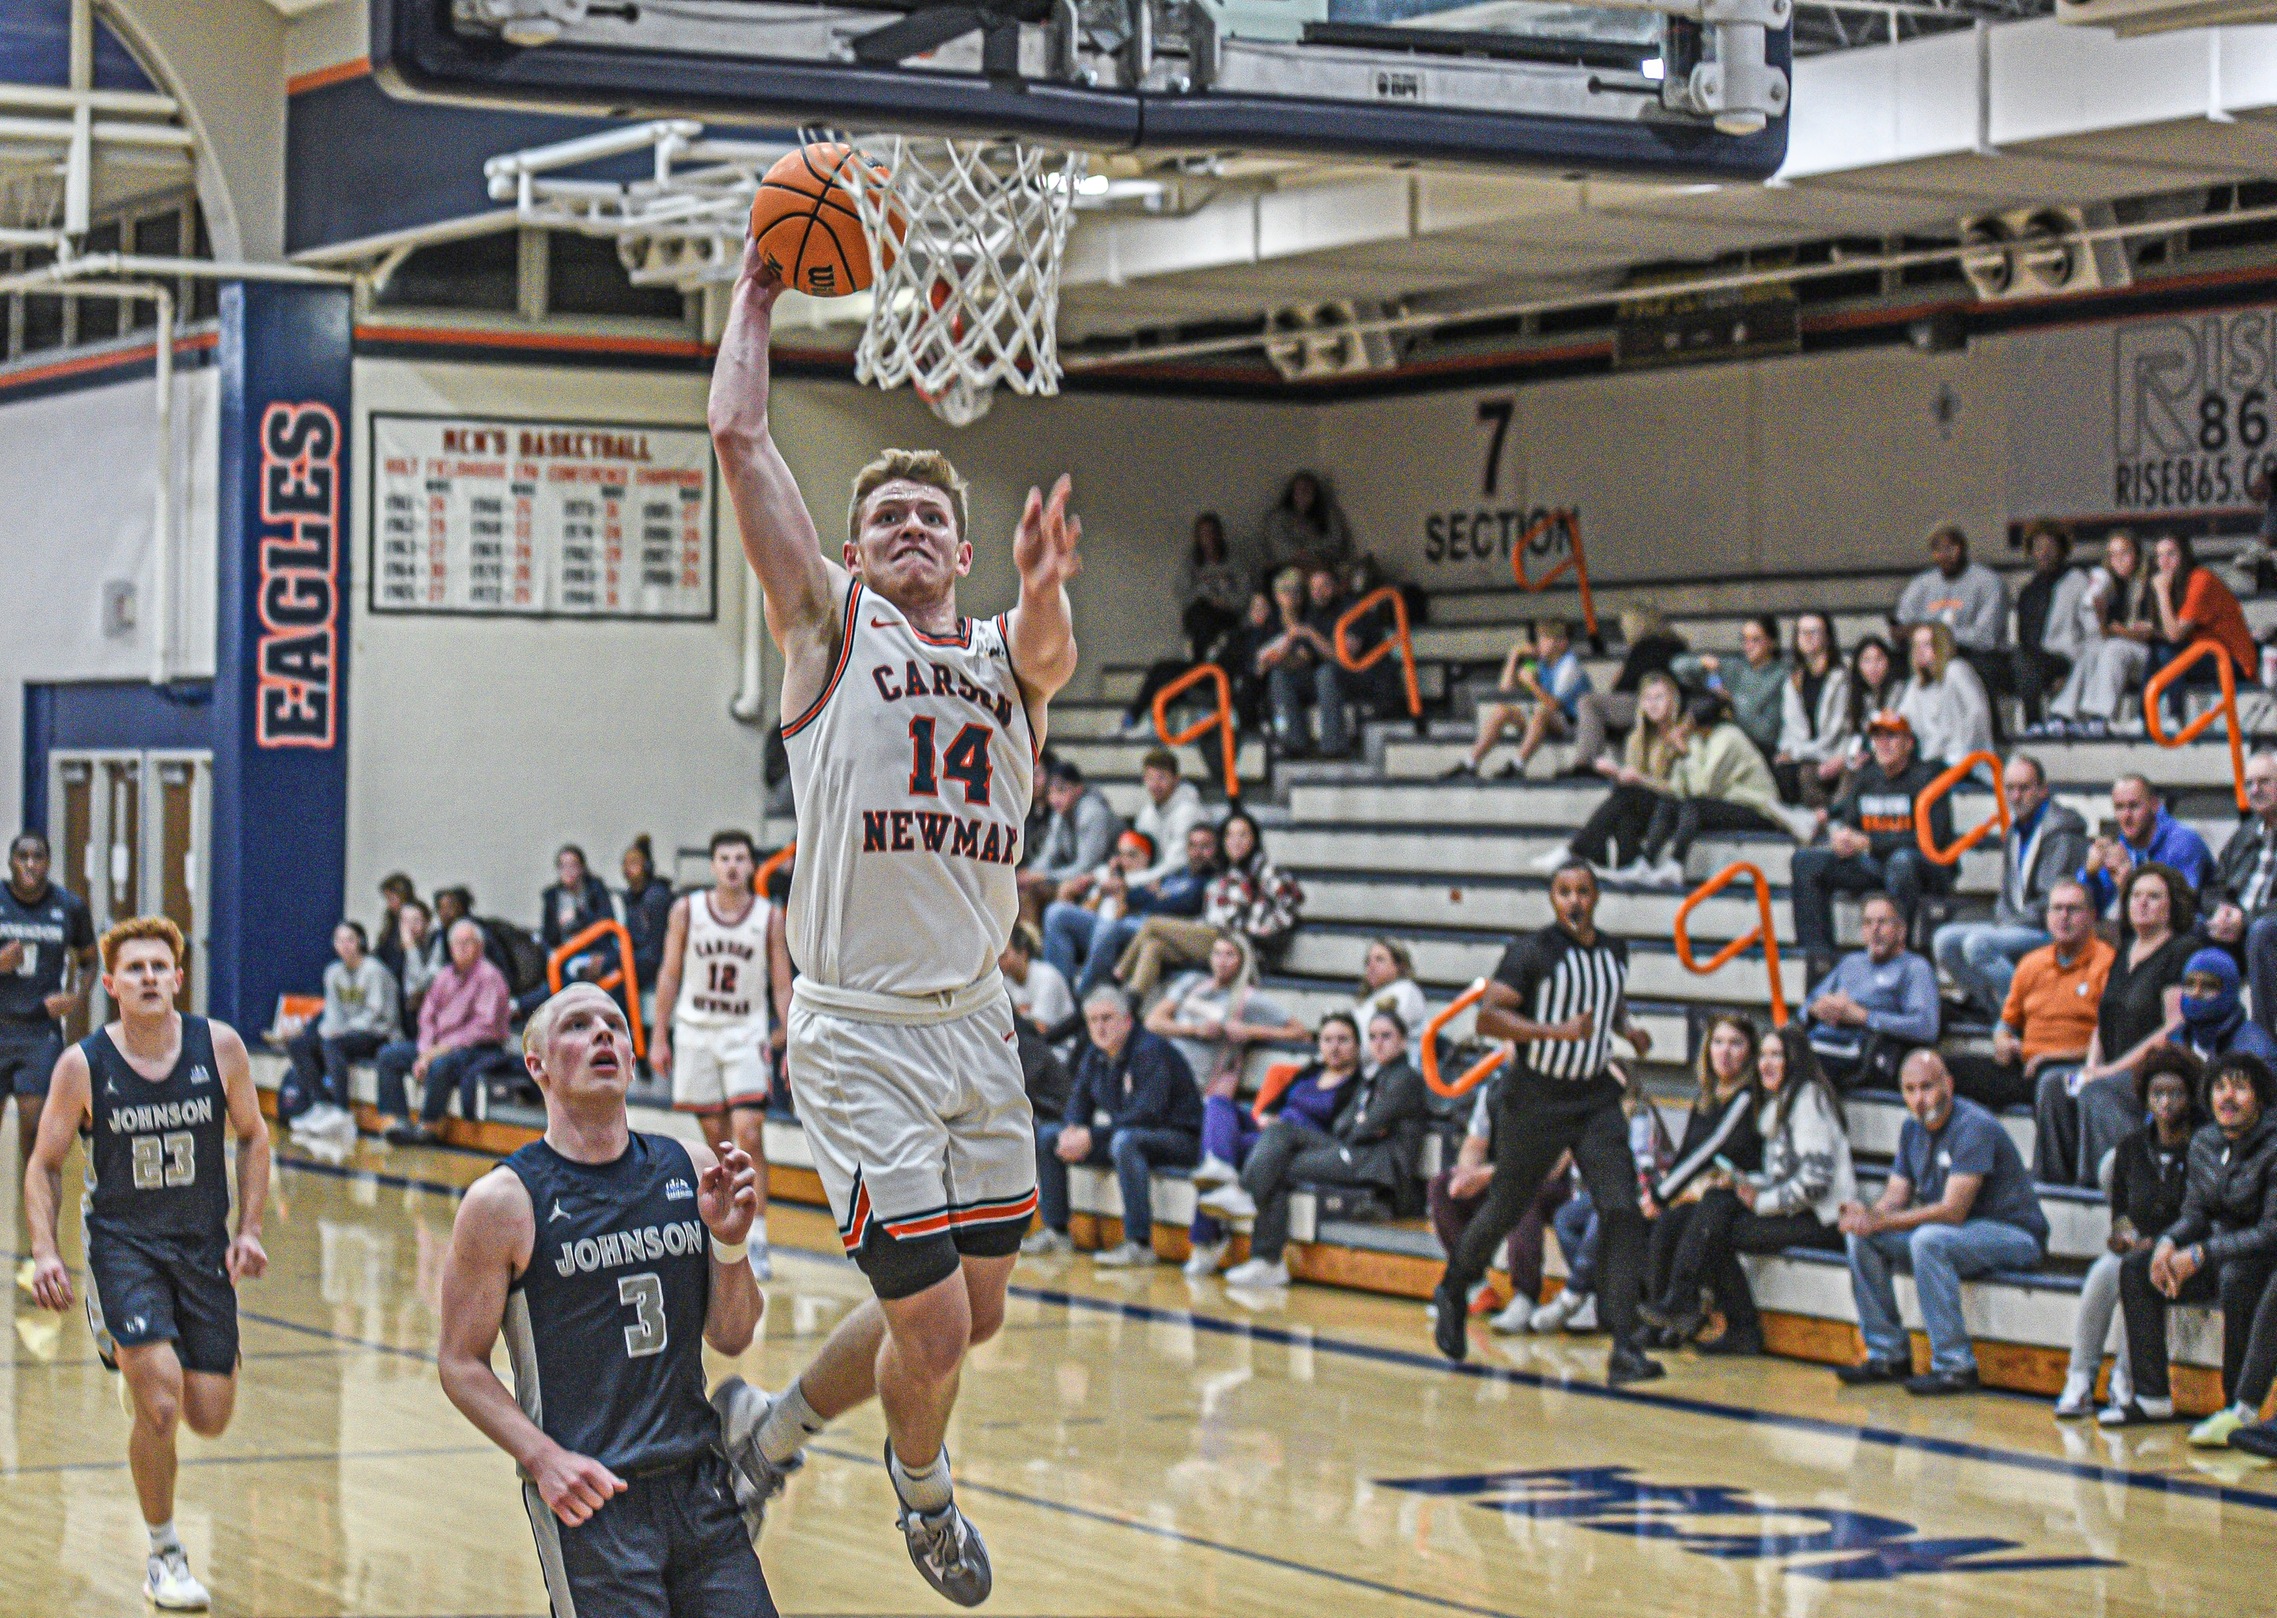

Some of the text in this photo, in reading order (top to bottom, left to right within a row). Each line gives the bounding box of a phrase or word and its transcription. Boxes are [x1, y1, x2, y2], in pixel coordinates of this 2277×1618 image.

[2114, 312, 2277, 456] RIS
[444, 429, 652, 461] MEN'S BASKETBALL
[1478, 401, 1514, 495] 7
[1426, 505, 1579, 564] SECTION
[258, 402, 341, 749] EAGLES
[909, 714, 994, 806] 14
[707, 961, 737, 994] 12
[107, 1095, 213, 1135] JOHNSON
[131, 1130, 196, 1190] 23
[554, 1218, 703, 1278] JOHNSON
[617, 1271, 669, 1359] 3
